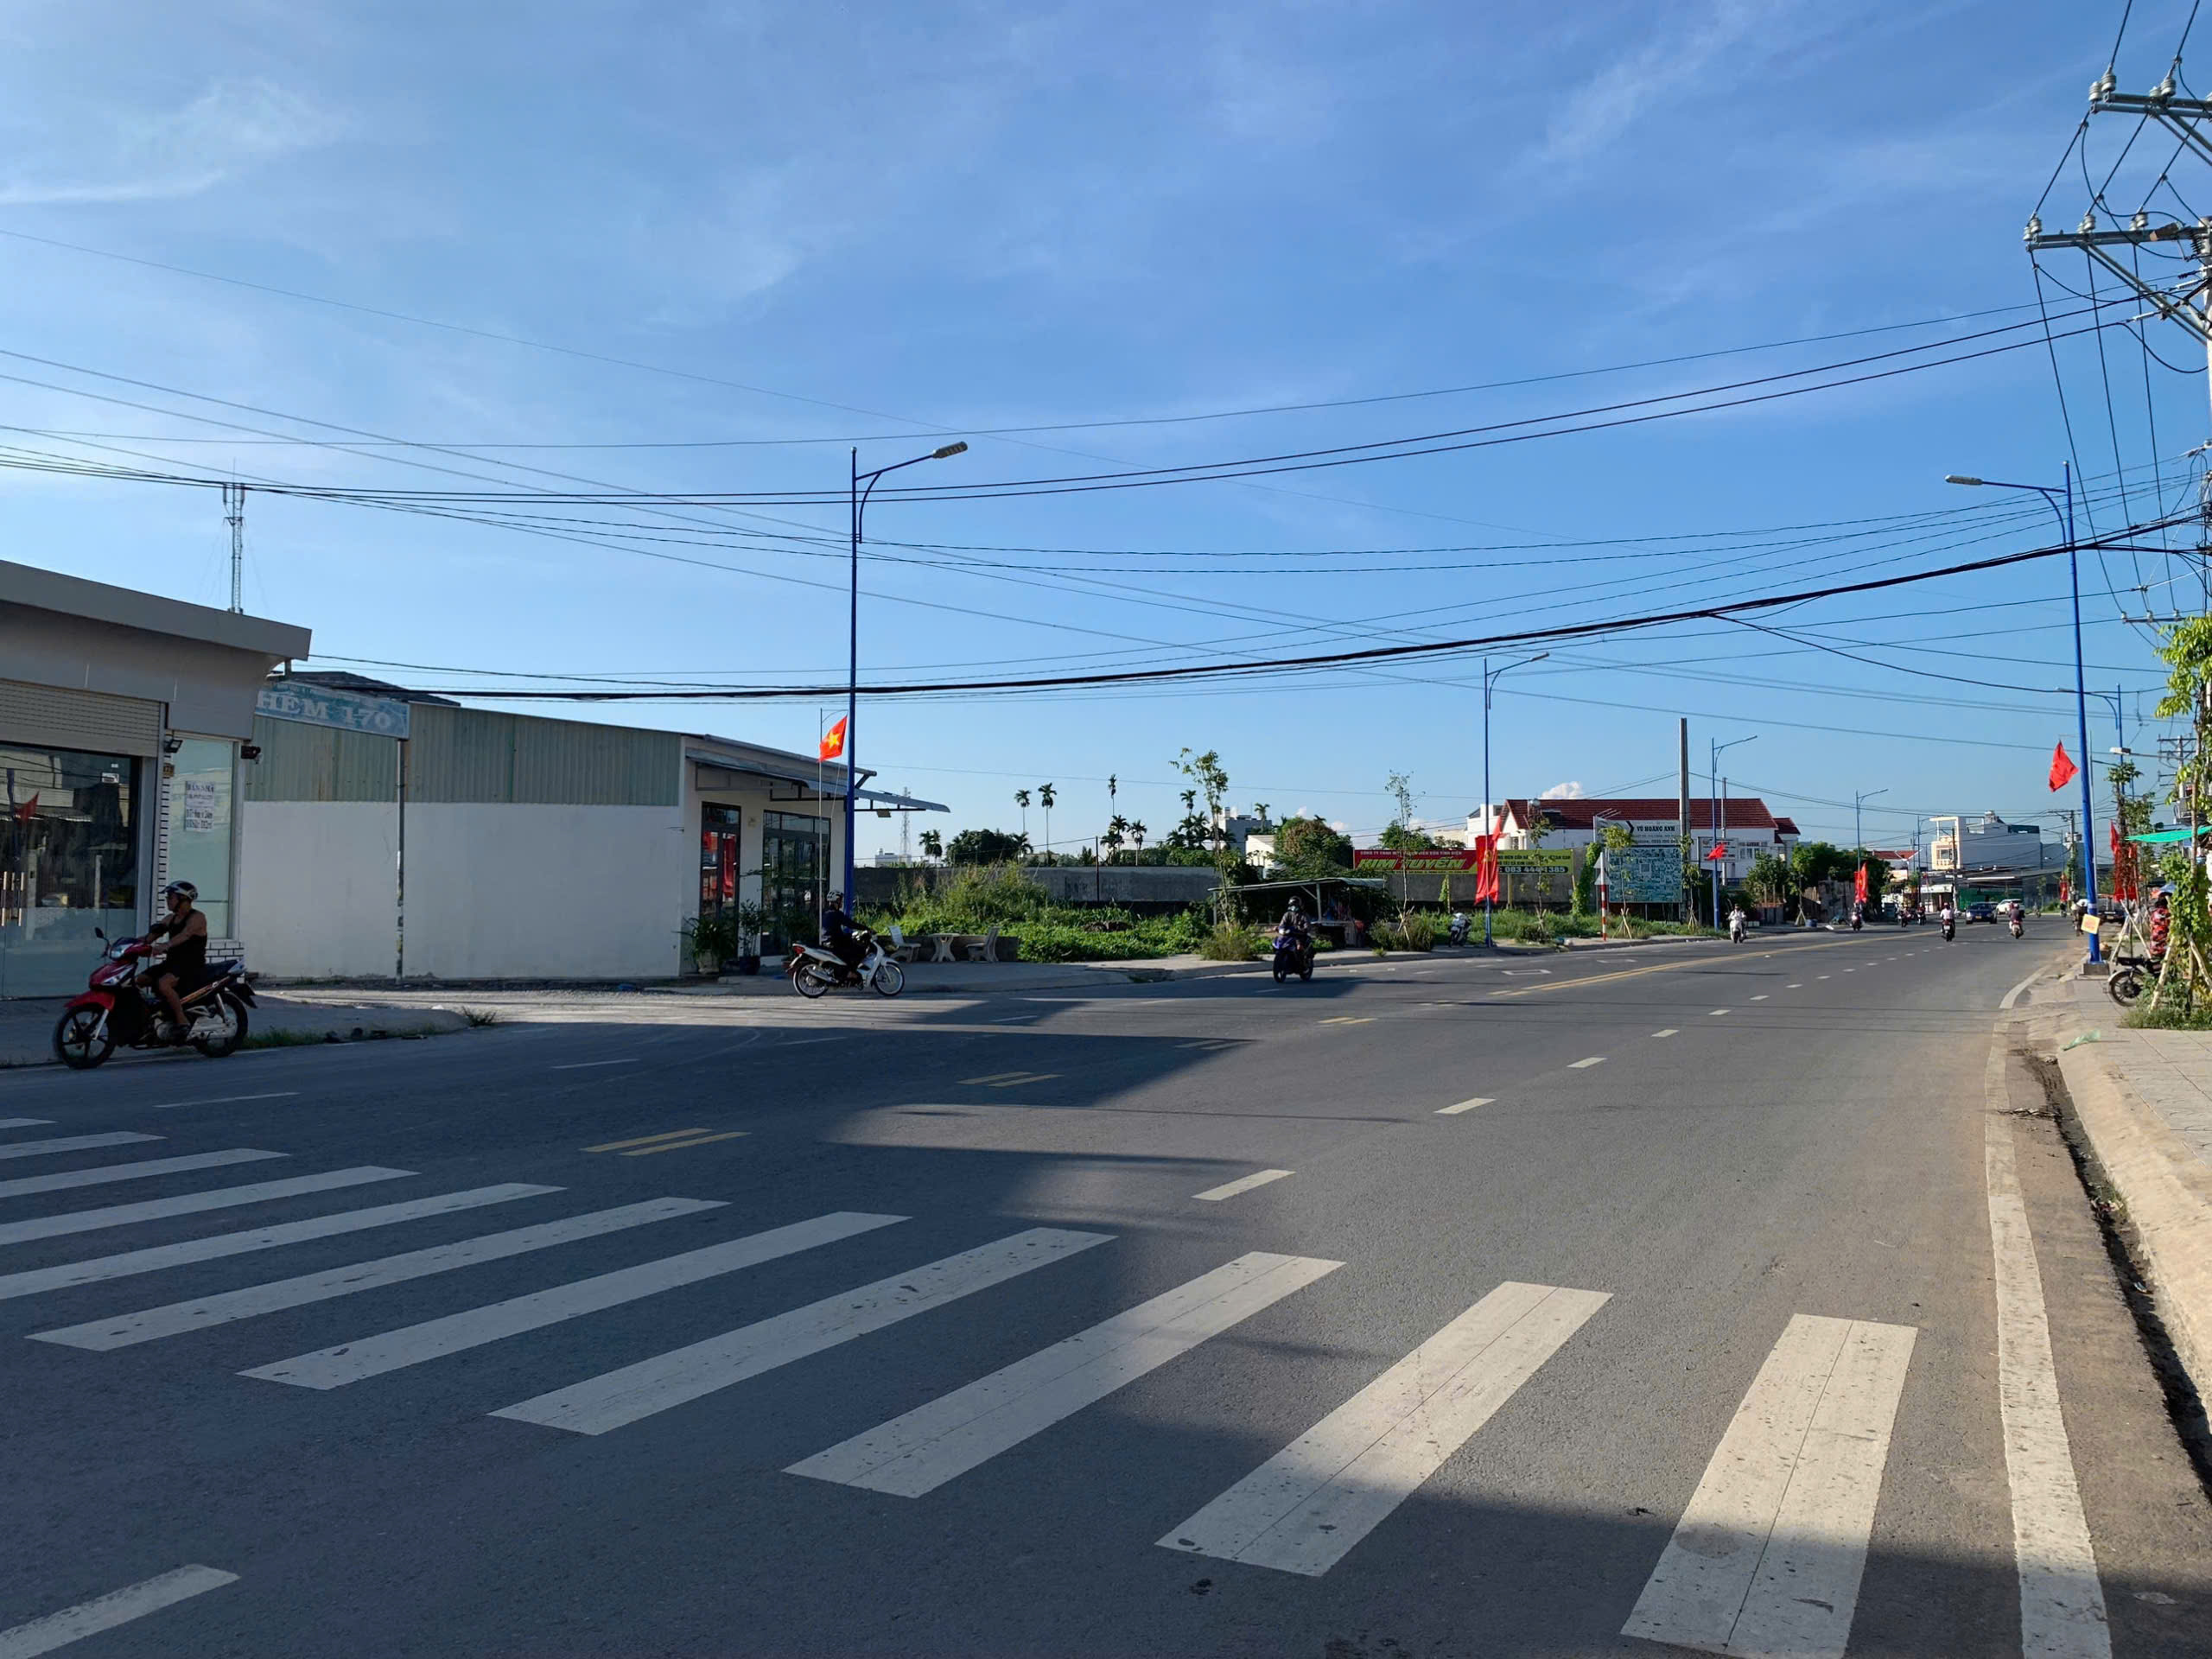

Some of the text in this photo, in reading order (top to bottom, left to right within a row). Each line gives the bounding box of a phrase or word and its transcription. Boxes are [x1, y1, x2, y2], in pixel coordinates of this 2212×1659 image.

[342, 706, 392, 729] 170
[1356, 855, 1467, 870] KIM TUYẾN
